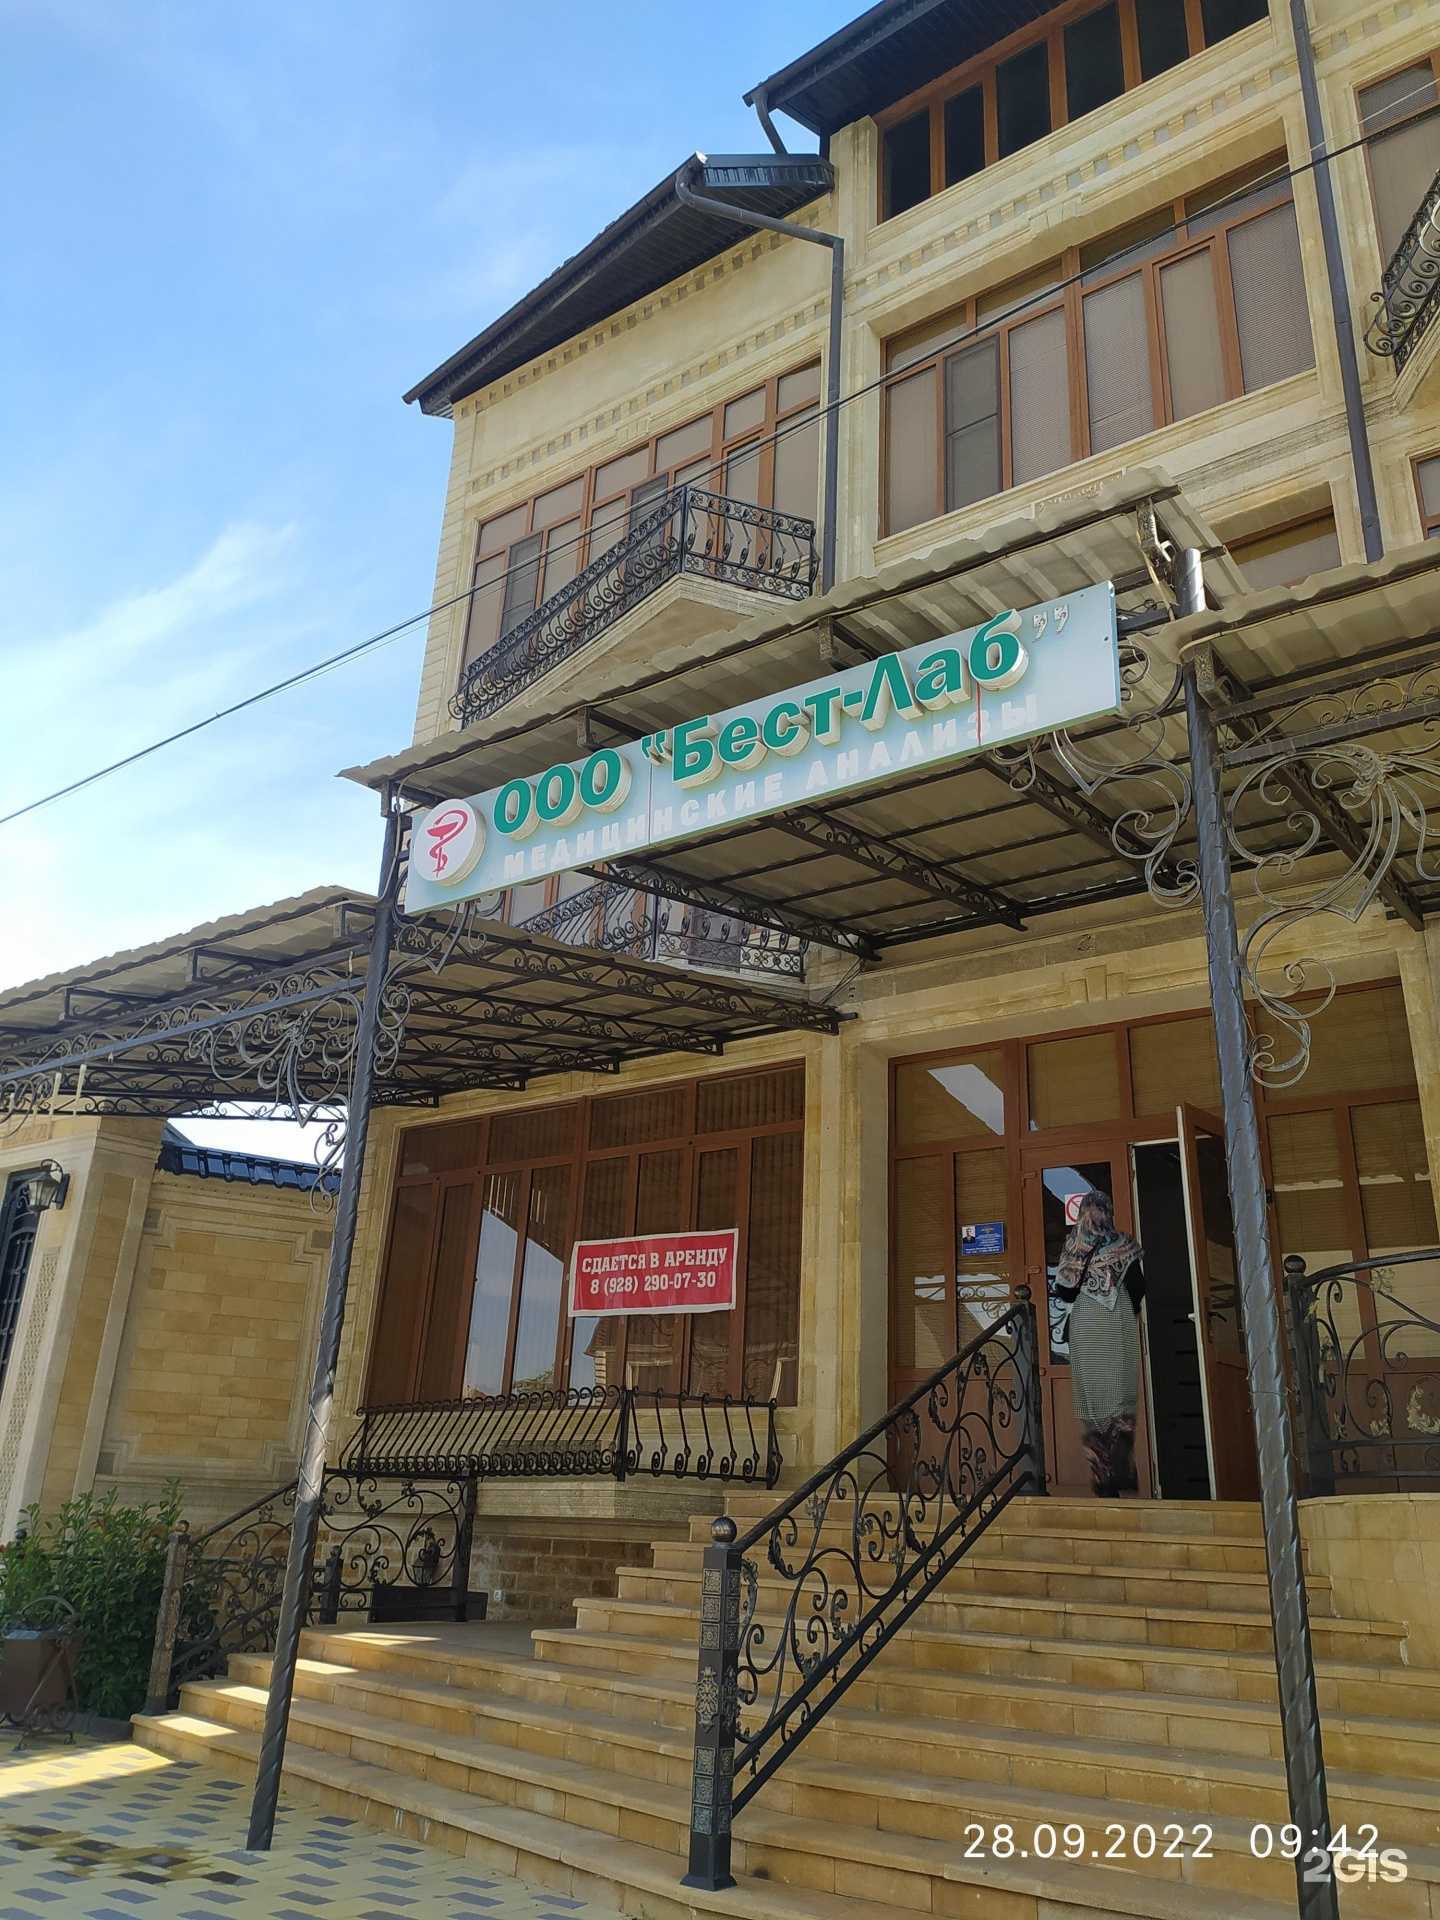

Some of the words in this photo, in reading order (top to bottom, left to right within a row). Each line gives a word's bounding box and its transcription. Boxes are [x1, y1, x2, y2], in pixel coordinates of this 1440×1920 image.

[493, 748, 629, 839] ООО
[504, 772, 784, 880] МЕДИЦИНСКИЕ
[805, 693, 1039, 791] АНАЛИЗЫ
[581, 1253, 647, 1275] СДАЕТСЯ
[650, 1252, 660, 1269] В
[664, 1247, 728, 1269] АРЕНДУ
[590, 1279, 600, 1295] 8
[604, 1276, 639, 1297] (928)
[643, 1271, 717, 1292] 290-07-30
